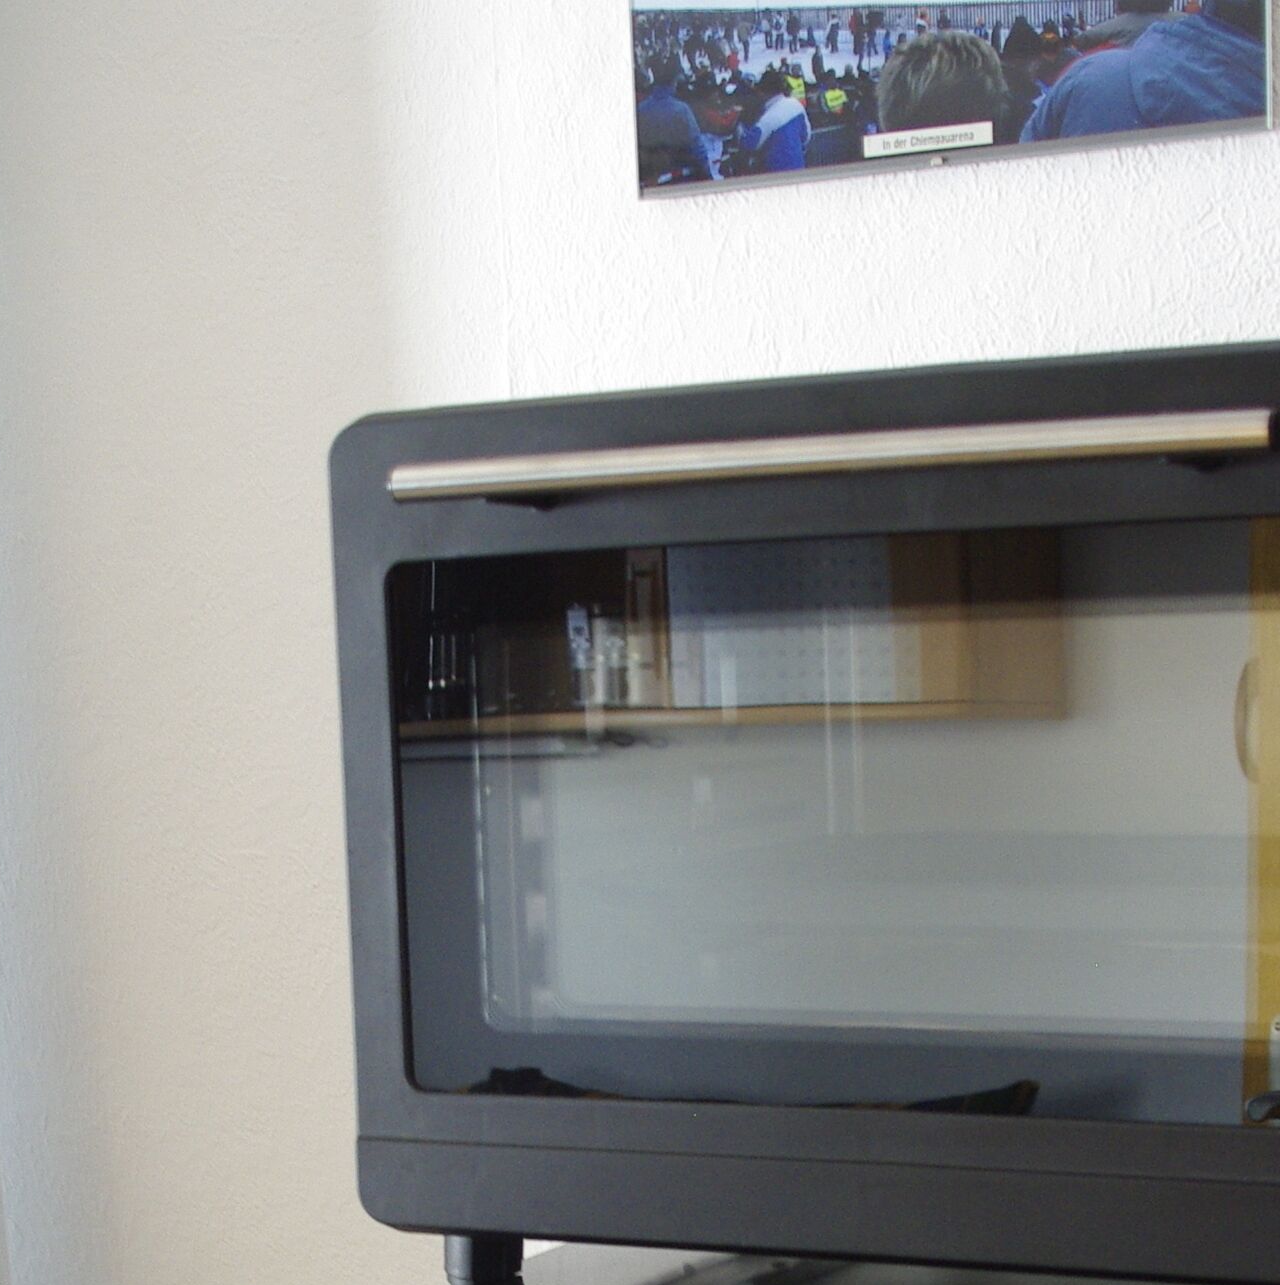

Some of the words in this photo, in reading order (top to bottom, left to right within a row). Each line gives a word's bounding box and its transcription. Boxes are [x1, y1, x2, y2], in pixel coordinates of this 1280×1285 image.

[882, 138, 891, 150] In
[894, 136, 907, 149] der
[910, 130, 975, 147] Chiemgauarena
